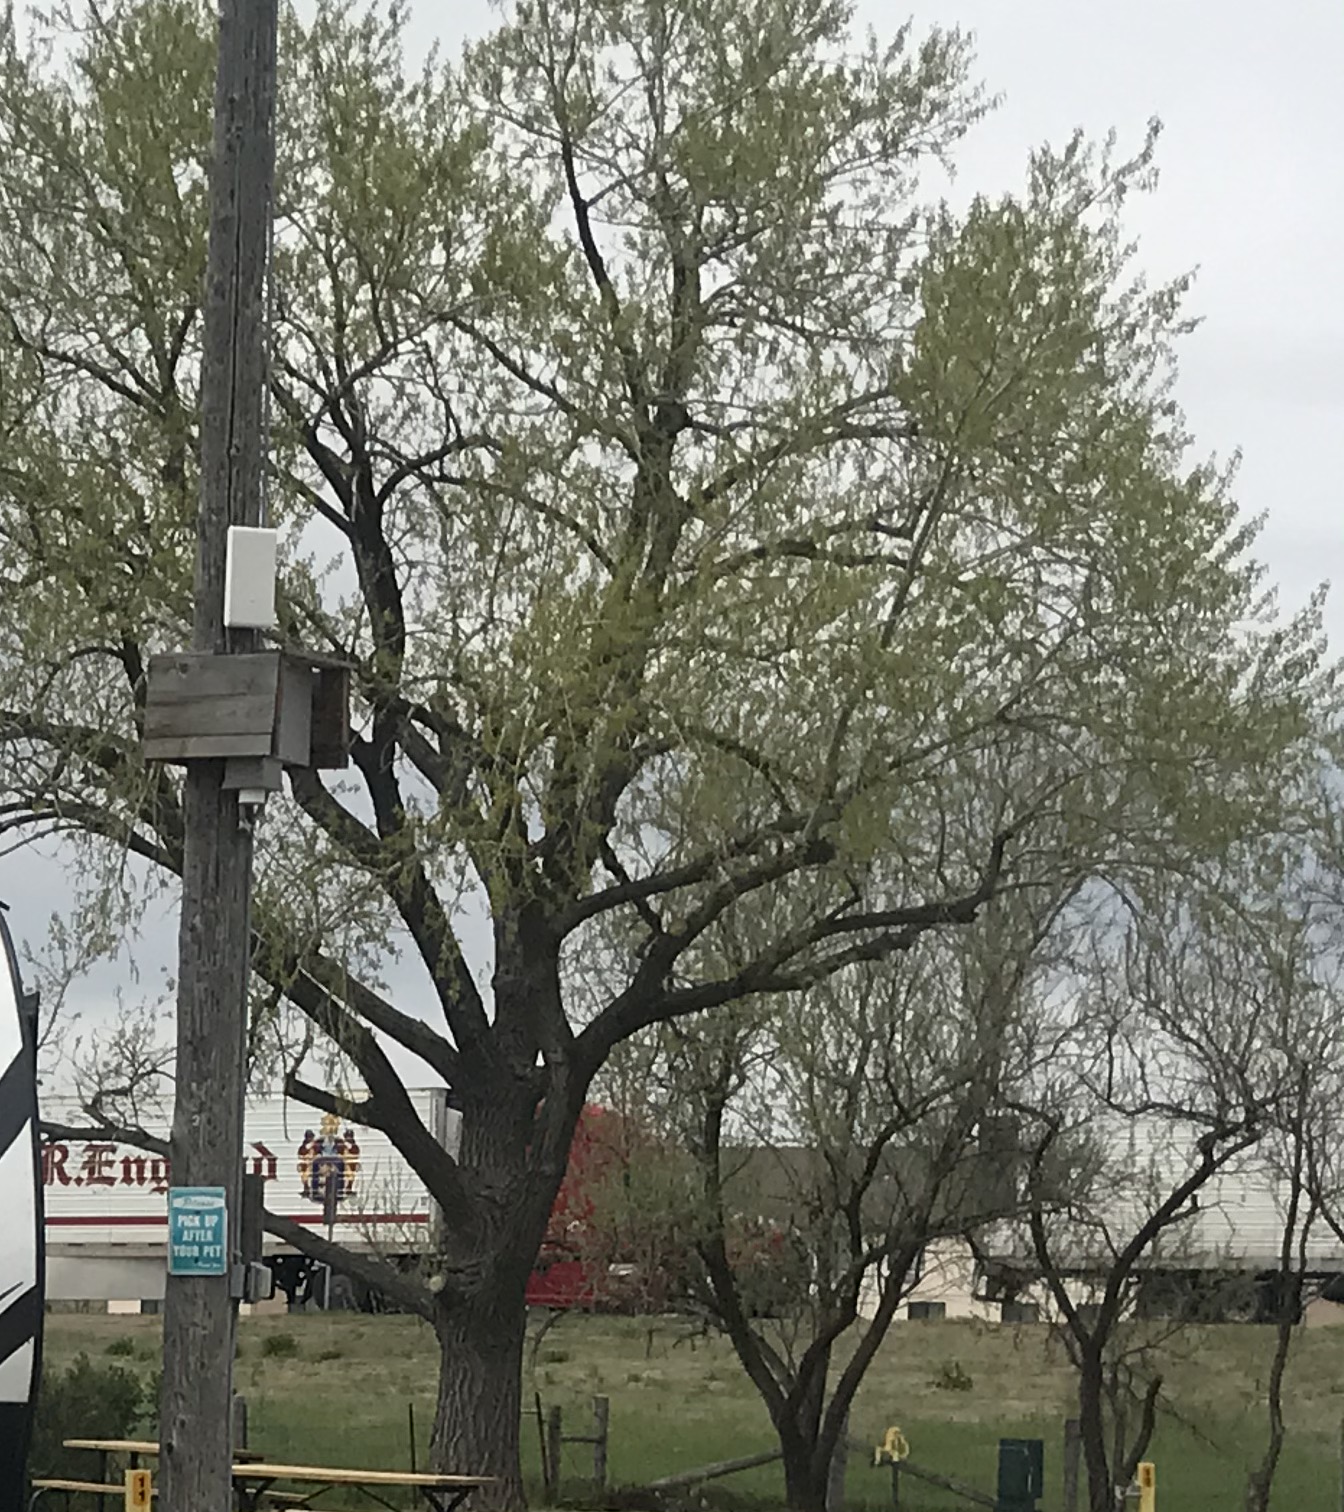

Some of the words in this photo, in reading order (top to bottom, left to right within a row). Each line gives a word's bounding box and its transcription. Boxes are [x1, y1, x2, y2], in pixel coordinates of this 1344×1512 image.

[177, 1214, 201, 1228] PICK
[204, 1214, 219, 1228] UP
[182, 1229, 214, 1242] AFTER
[173, 1244, 200, 1257] YOUR
[202, 1244, 222, 1258] PET
